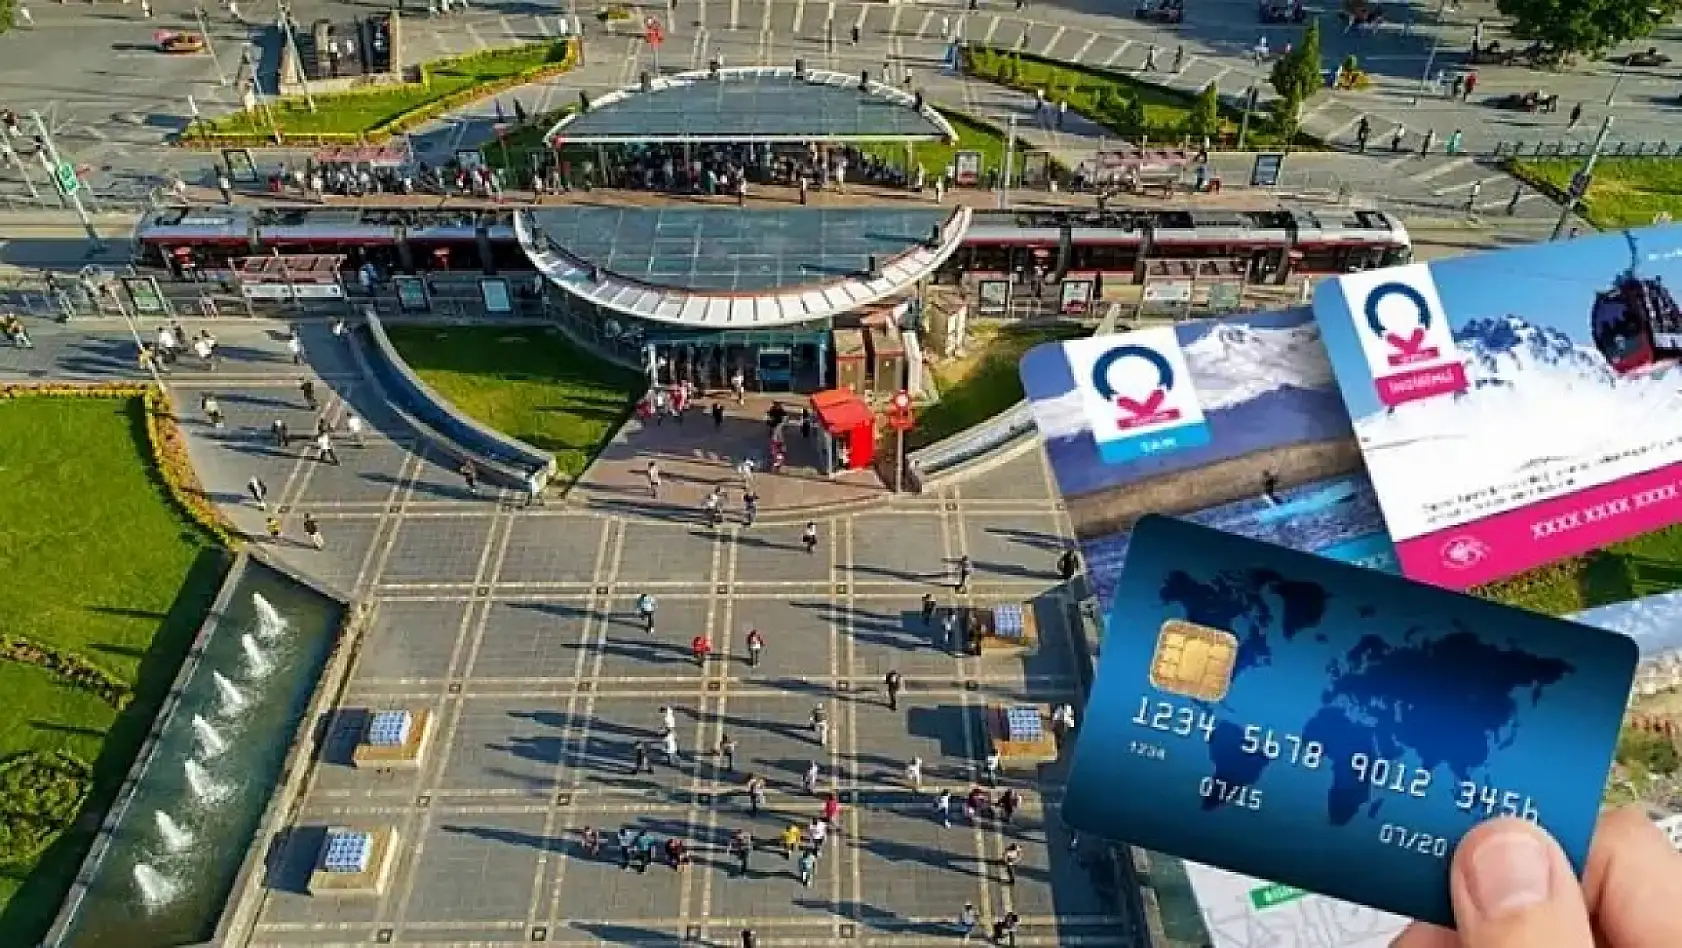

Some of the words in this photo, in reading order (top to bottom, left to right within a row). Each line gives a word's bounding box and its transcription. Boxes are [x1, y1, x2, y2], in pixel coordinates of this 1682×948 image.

[1132, 696, 1216, 742] 1234
[1241, 724, 1325, 769] 5678
[1350, 753, 1432, 797] 9012
[1200, 776, 1263, 811] 07/15
[1378, 824, 1448, 857] 07/20
